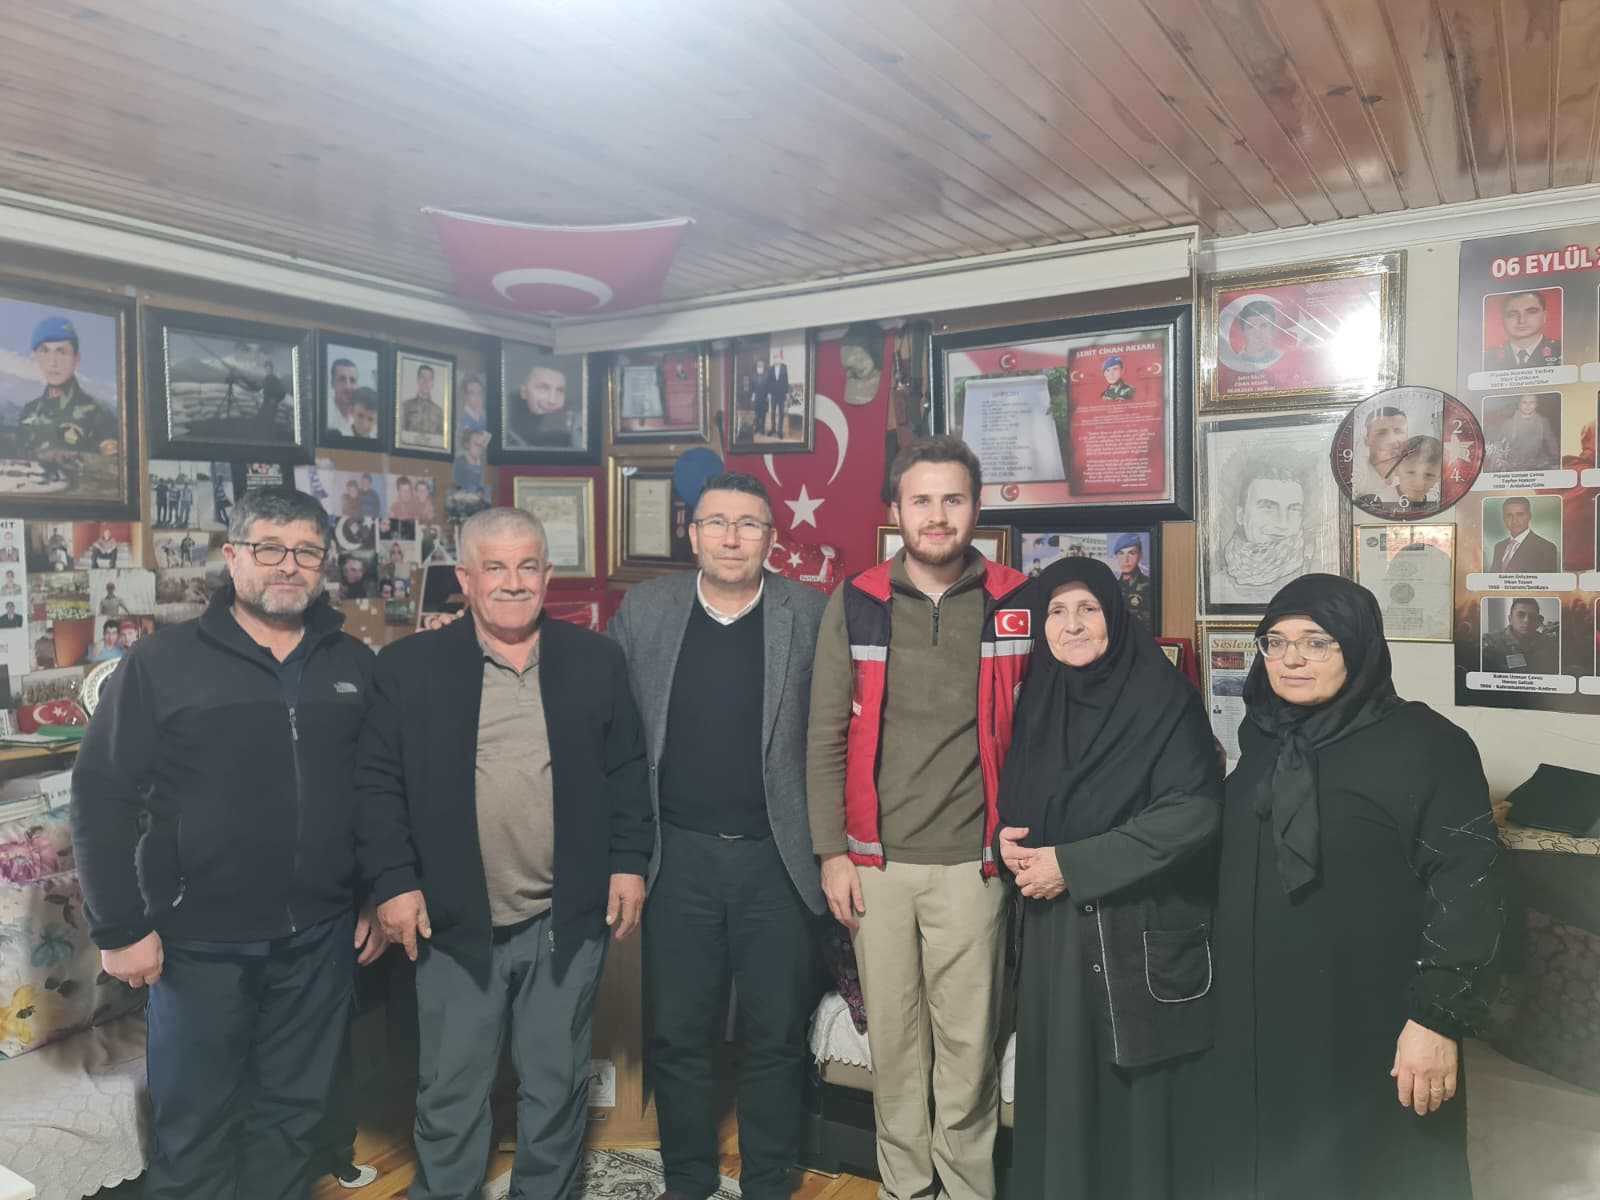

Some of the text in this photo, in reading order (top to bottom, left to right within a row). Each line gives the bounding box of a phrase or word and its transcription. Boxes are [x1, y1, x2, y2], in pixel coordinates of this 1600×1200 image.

[1491, 258, 1521, 278] 06
[1525, 246, 1593, 274] EYLÜL
[1098, 345, 1124, 354] CİHAN
[1453, 420, 1463, 434] 2
[1343, 449, 1353, 463] 9
[1450, 468, 1461, 482] 4
[1399, 495, 1410, 508] 6
